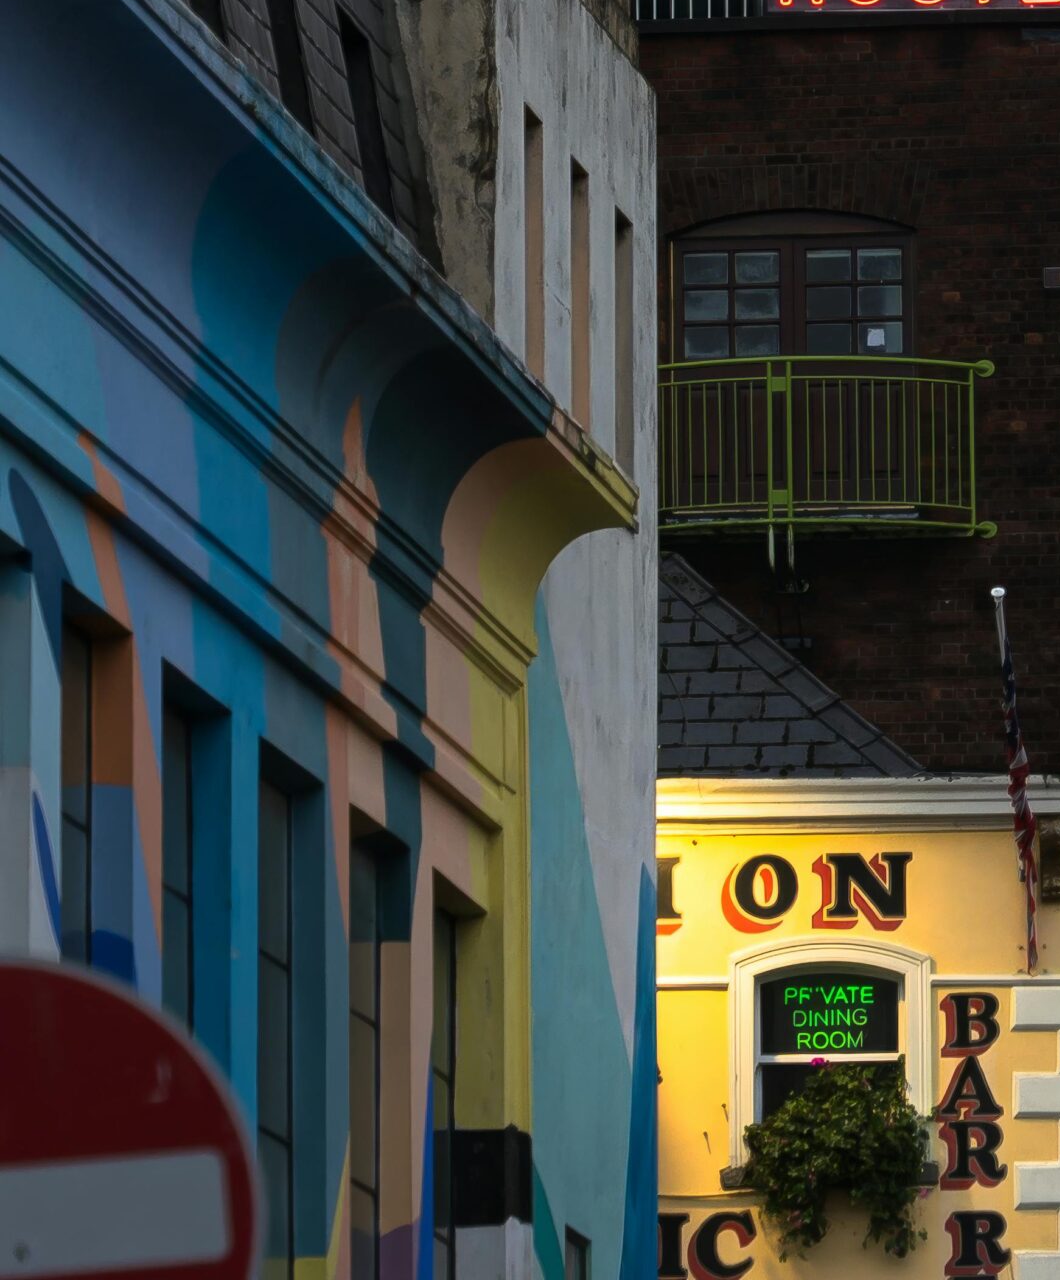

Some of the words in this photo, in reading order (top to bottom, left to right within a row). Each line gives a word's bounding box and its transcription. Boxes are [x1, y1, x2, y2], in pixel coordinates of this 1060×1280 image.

[784, 985, 875, 1005] PRVATE
[792, 1008, 868, 1027] DINING
[797, 1031, 864, 1050] ROOM
[936, 991, 1008, 1191] BAR
